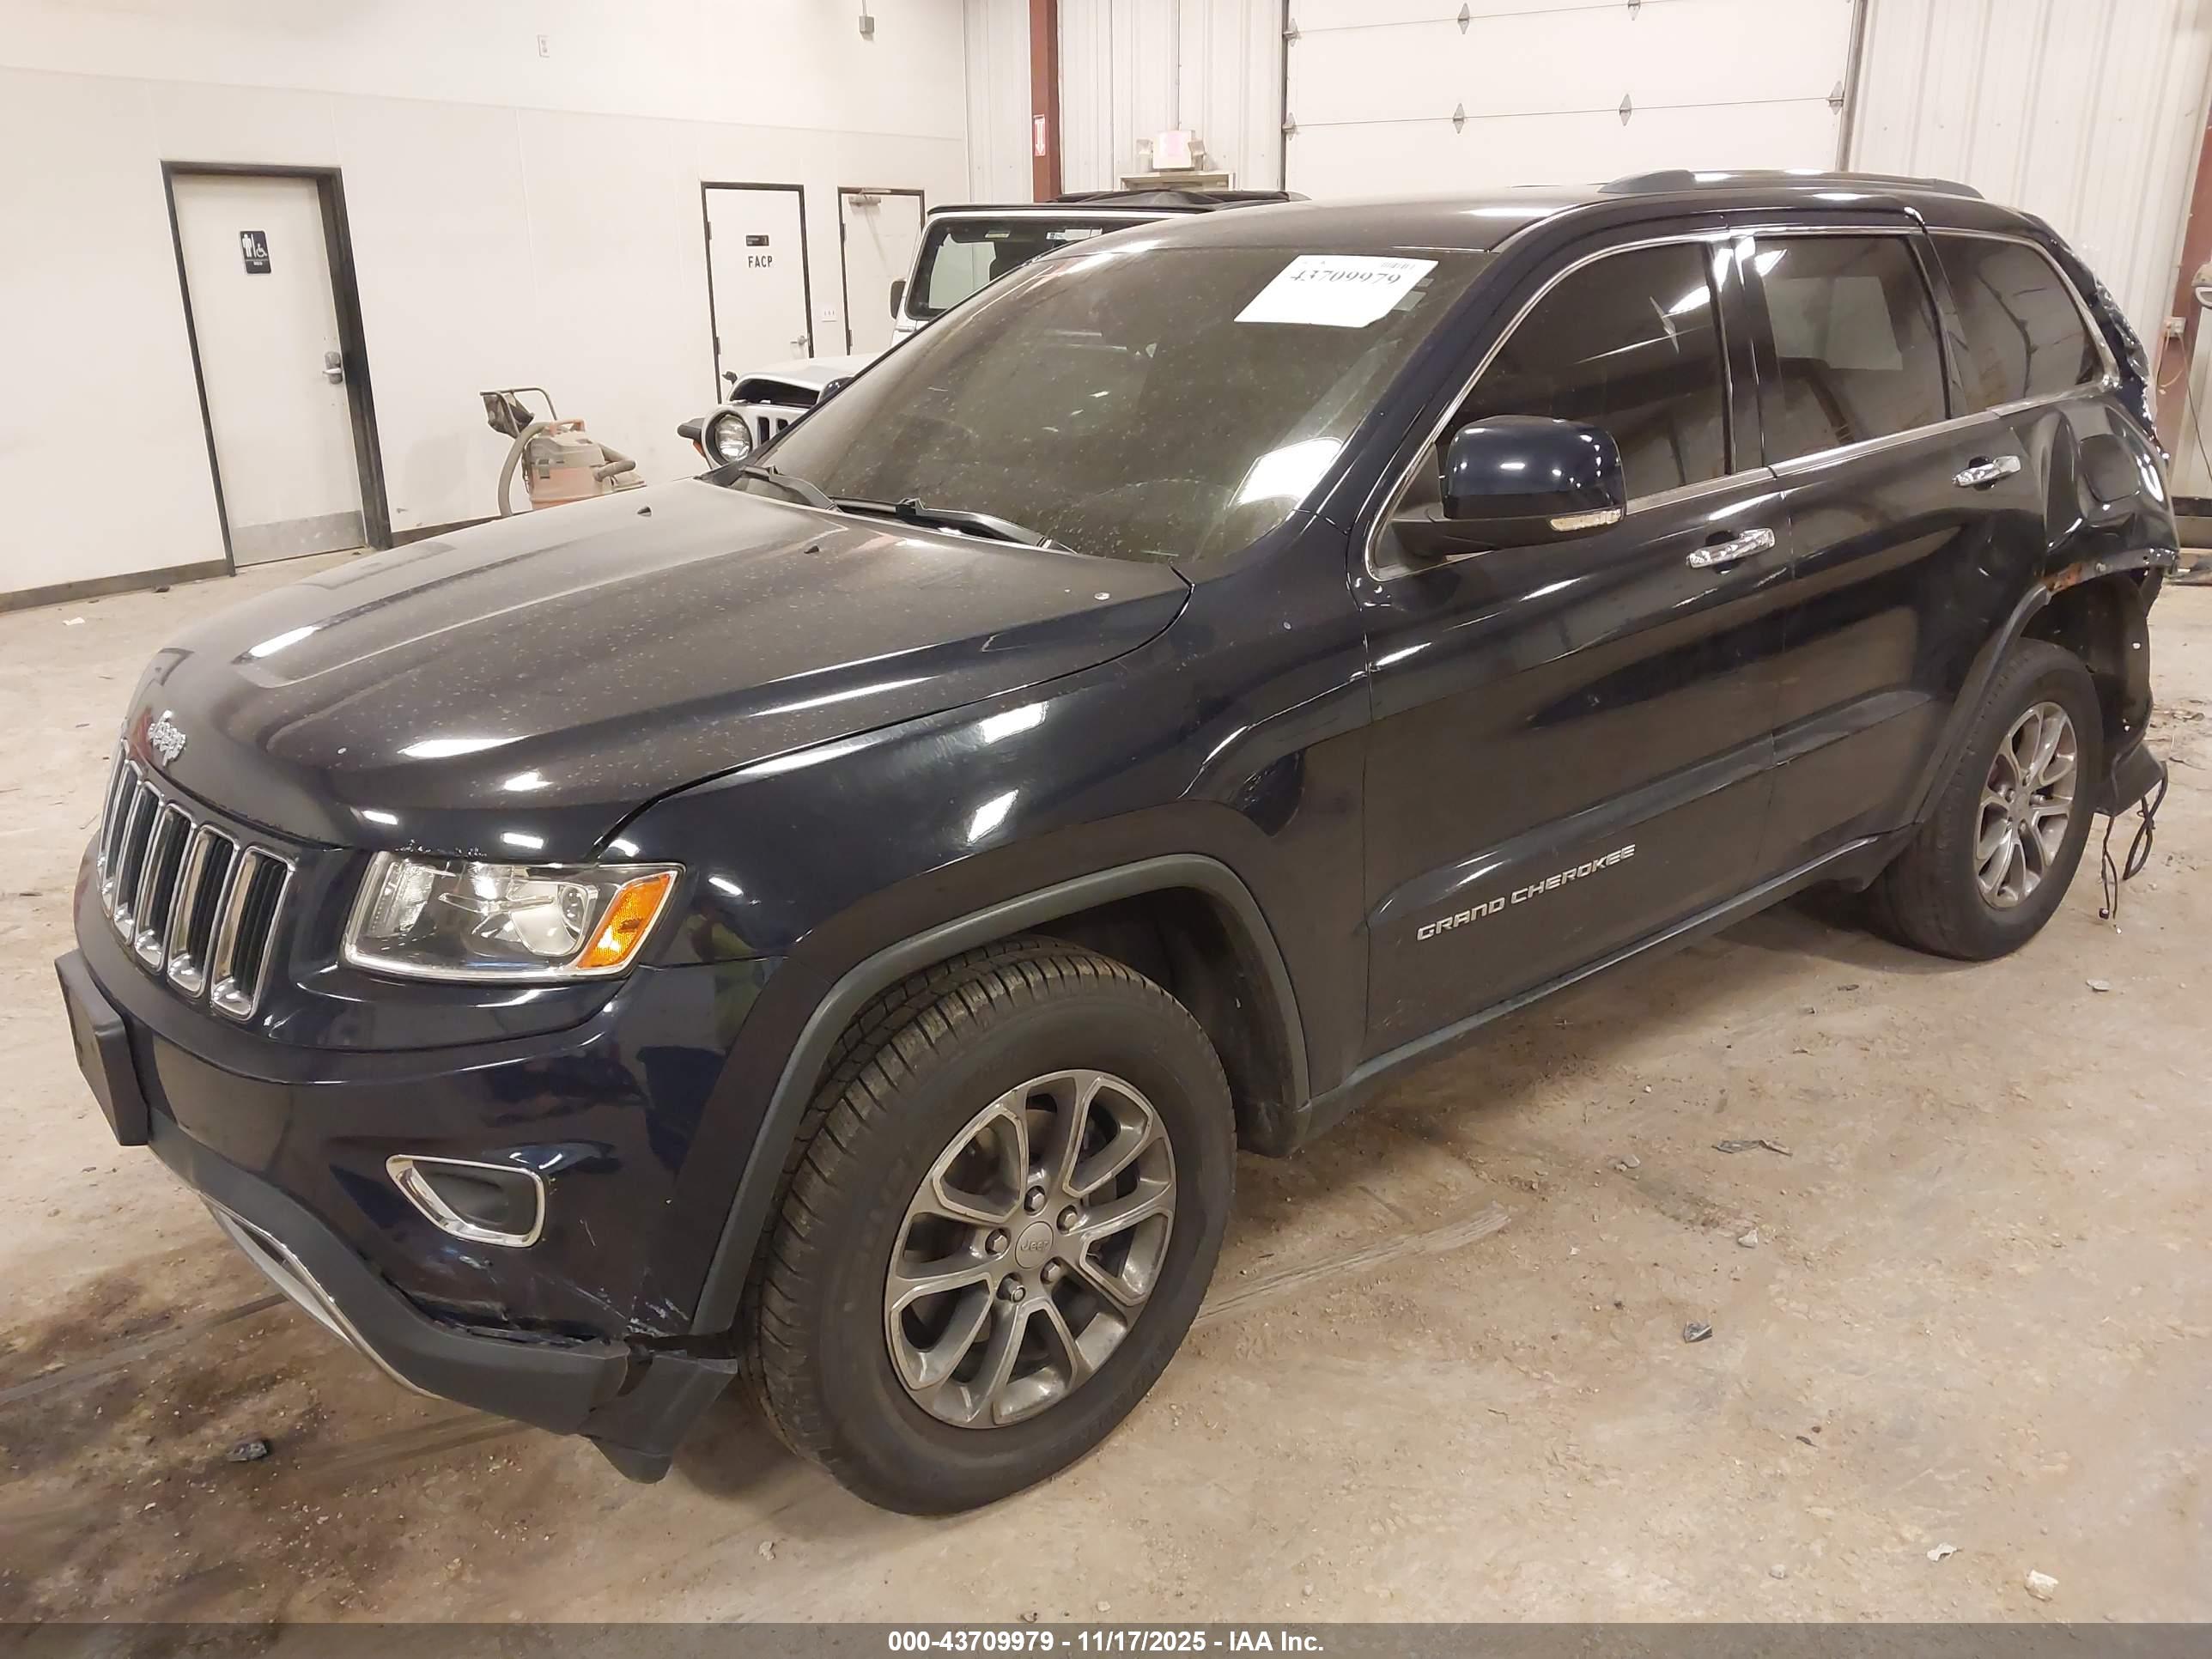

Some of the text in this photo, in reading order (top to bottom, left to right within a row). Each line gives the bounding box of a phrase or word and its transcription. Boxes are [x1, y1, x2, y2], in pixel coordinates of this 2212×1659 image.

[748, 255, 773, 268] FACP
[1290, 270, 1401, 284] 43709979
[1417, 843, 1636, 941] GRAND CHEROKEE
